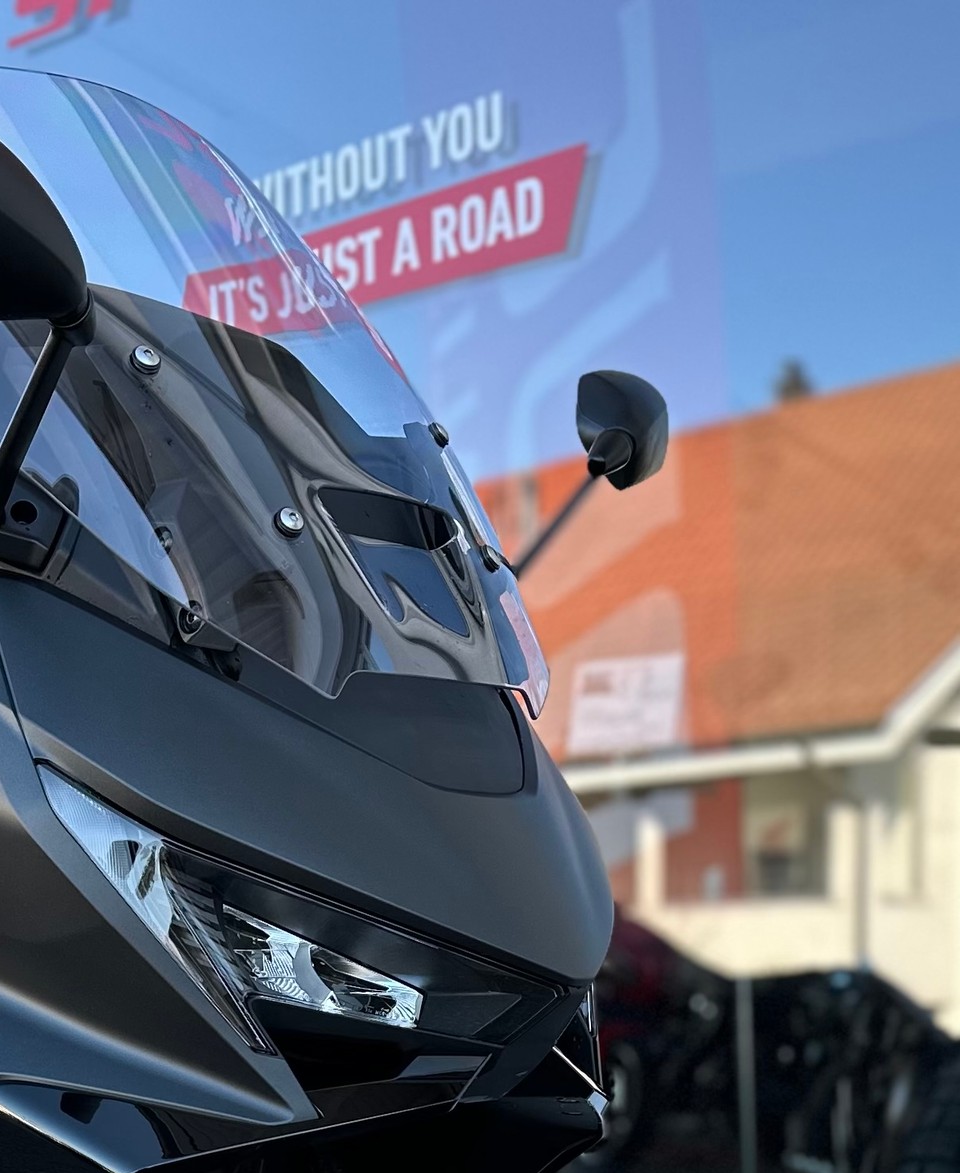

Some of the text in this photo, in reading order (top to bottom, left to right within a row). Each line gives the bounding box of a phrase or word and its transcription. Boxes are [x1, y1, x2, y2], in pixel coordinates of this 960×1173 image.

[225, 91, 503, 246] WITHOUT YOU
[208, 275, 269, 327] IT'S
[392, 217, 421, 276] A
[431, 176, 545, 263] ROAD
